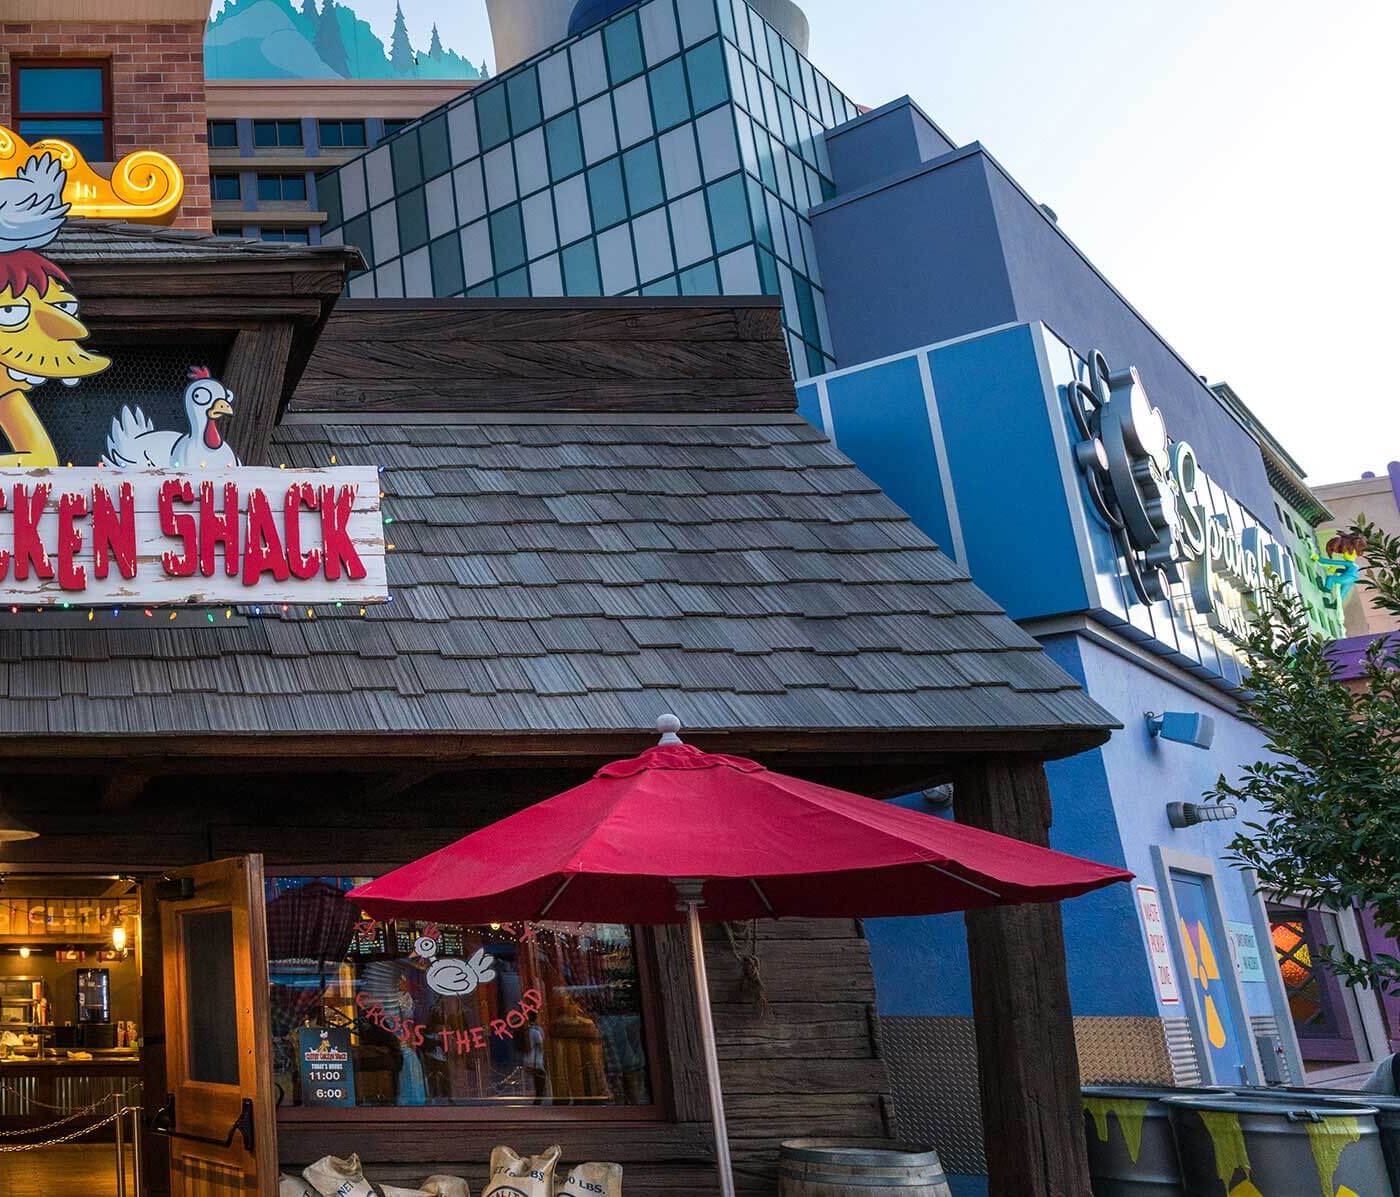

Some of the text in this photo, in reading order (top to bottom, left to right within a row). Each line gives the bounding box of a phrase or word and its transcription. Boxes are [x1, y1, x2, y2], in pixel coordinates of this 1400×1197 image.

[158, 480, 367, 586] SHACK
[439, 1027, 487, 1055] THE
[490, 988, 544, 1040] ROAD
[309, 1072, 340, 1080] 11:00
[316, 1089, 342, 1098] 6:00
[579, 1178, 605, 1195] LBS.
